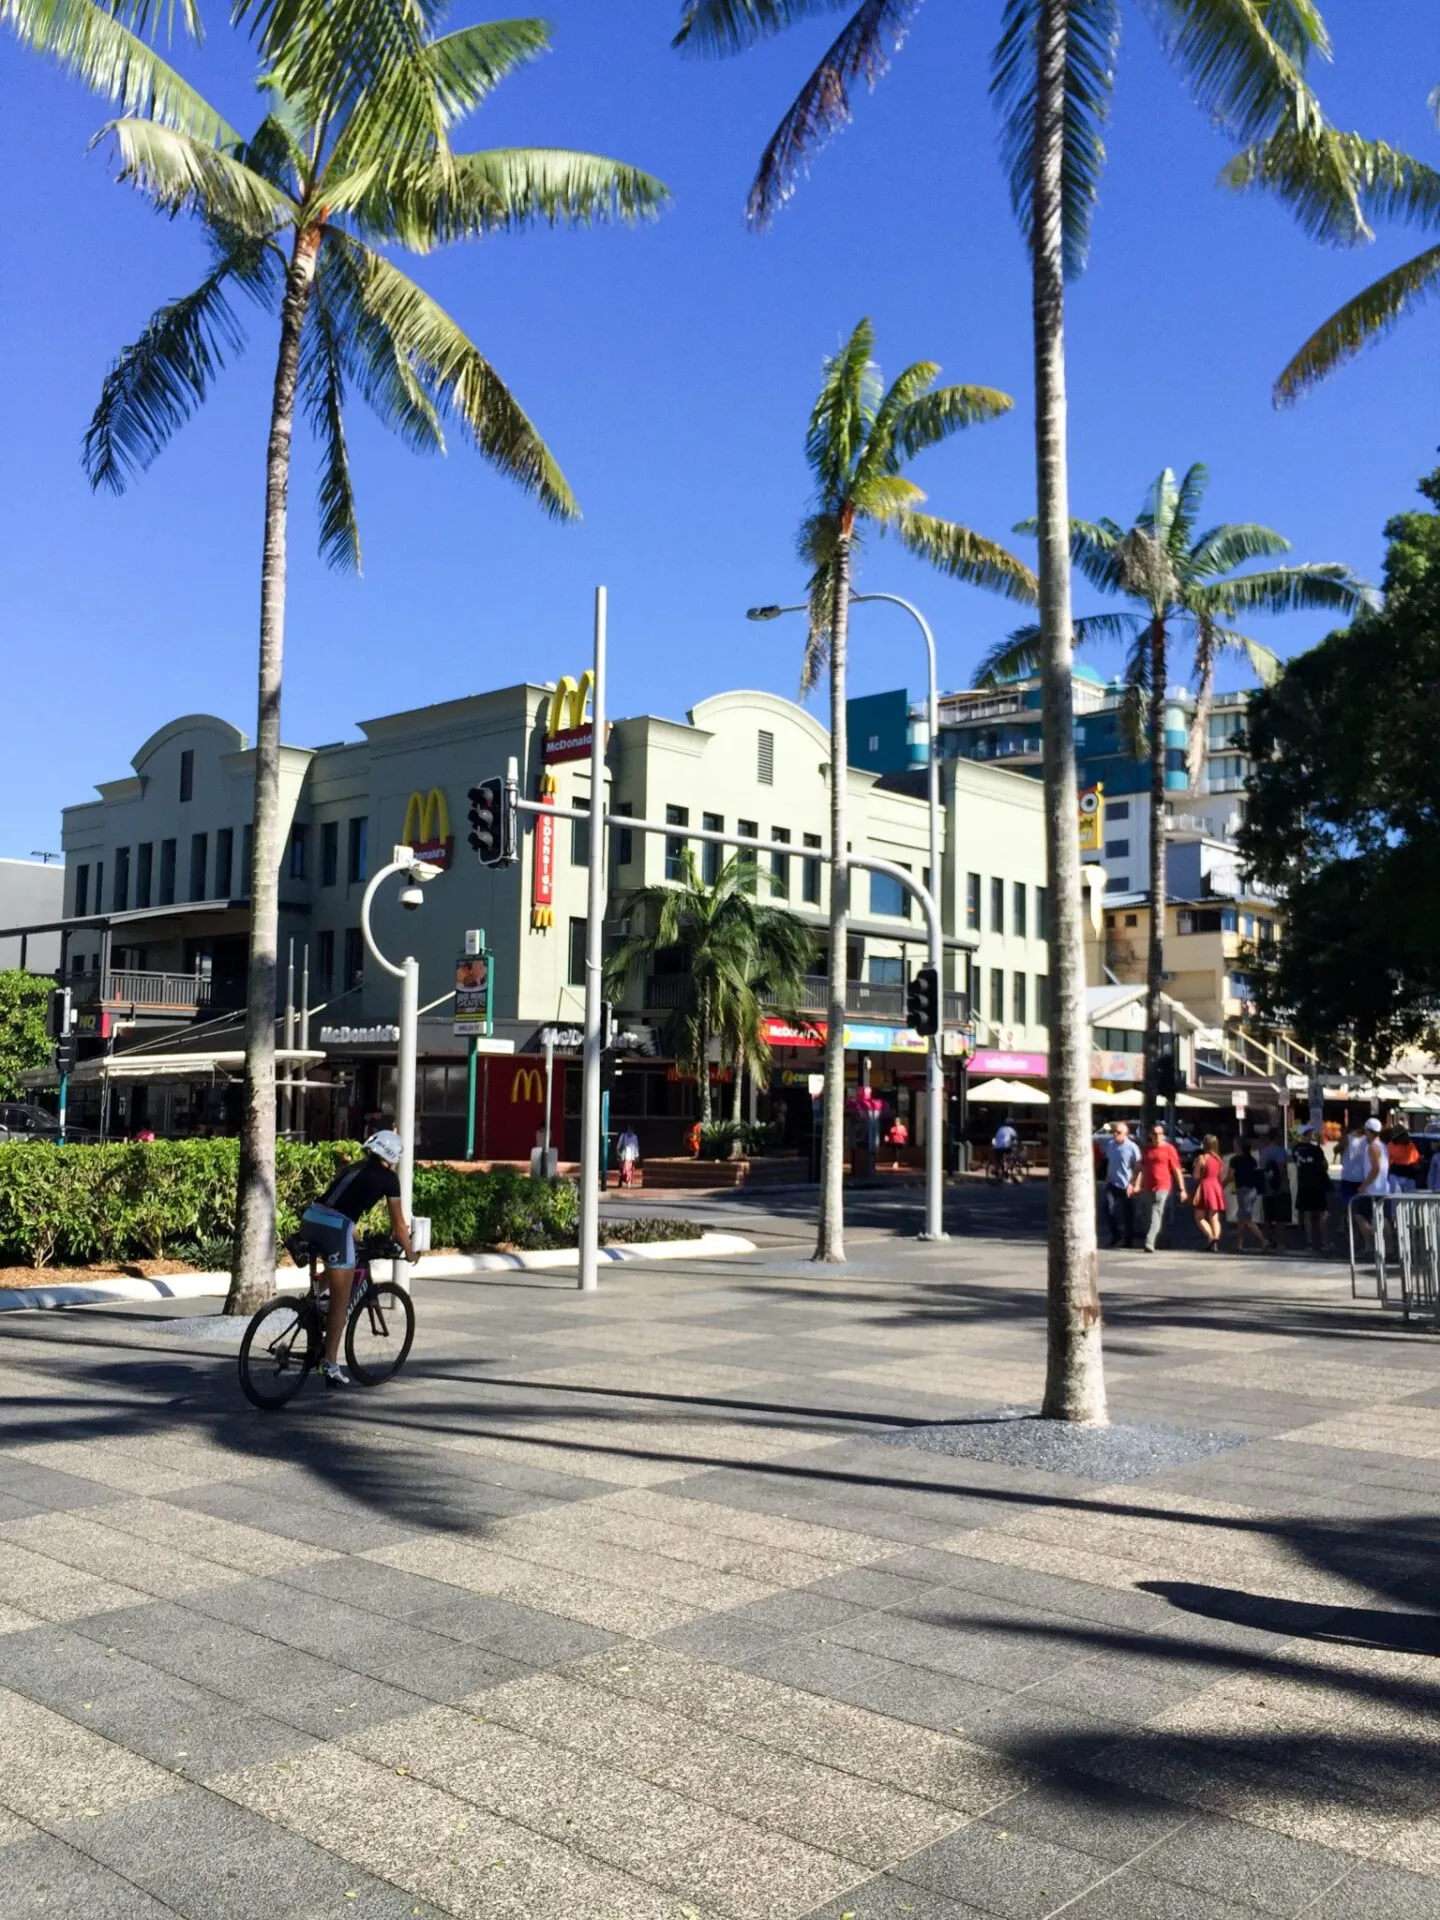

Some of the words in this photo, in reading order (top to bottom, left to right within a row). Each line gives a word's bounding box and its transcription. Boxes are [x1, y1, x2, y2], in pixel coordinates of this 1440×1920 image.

[546, 734, 593, 753] McDonald
[413, 848, 446, 860] Donald's
[542, 815, 556, 895] cDonald's
[320, 1024, 400, 1043] McDonald's
